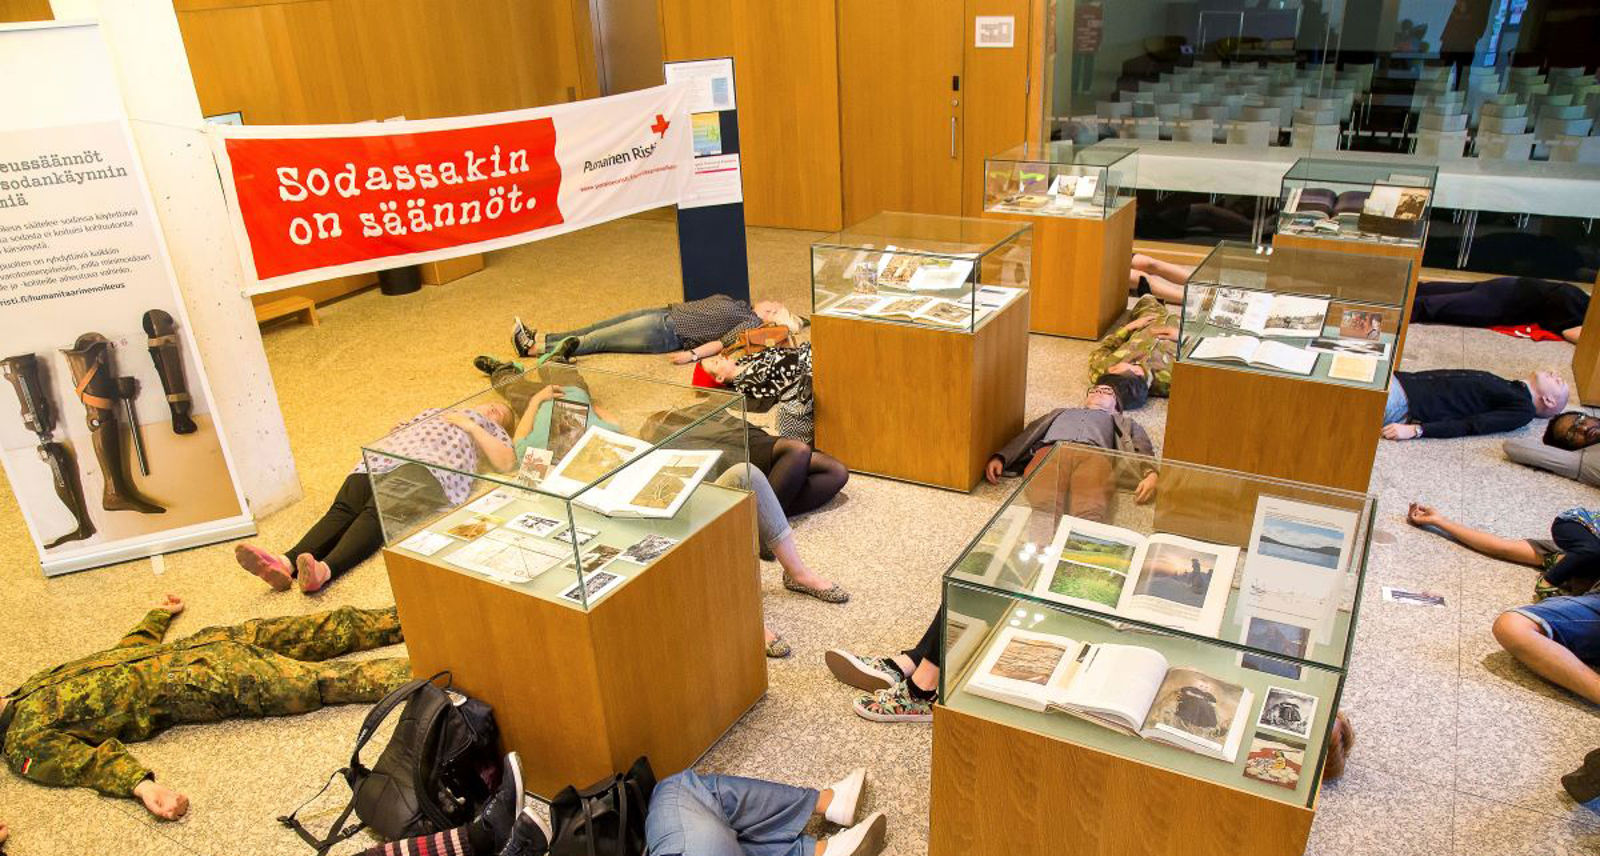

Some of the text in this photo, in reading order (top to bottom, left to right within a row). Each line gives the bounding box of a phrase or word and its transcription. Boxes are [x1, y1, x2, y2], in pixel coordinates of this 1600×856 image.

[0, 165, 128, 191] sodankäynnin
[276, 145, 530, 202] Sodassakin
[288, 183, 538, 246] on säännöt.
